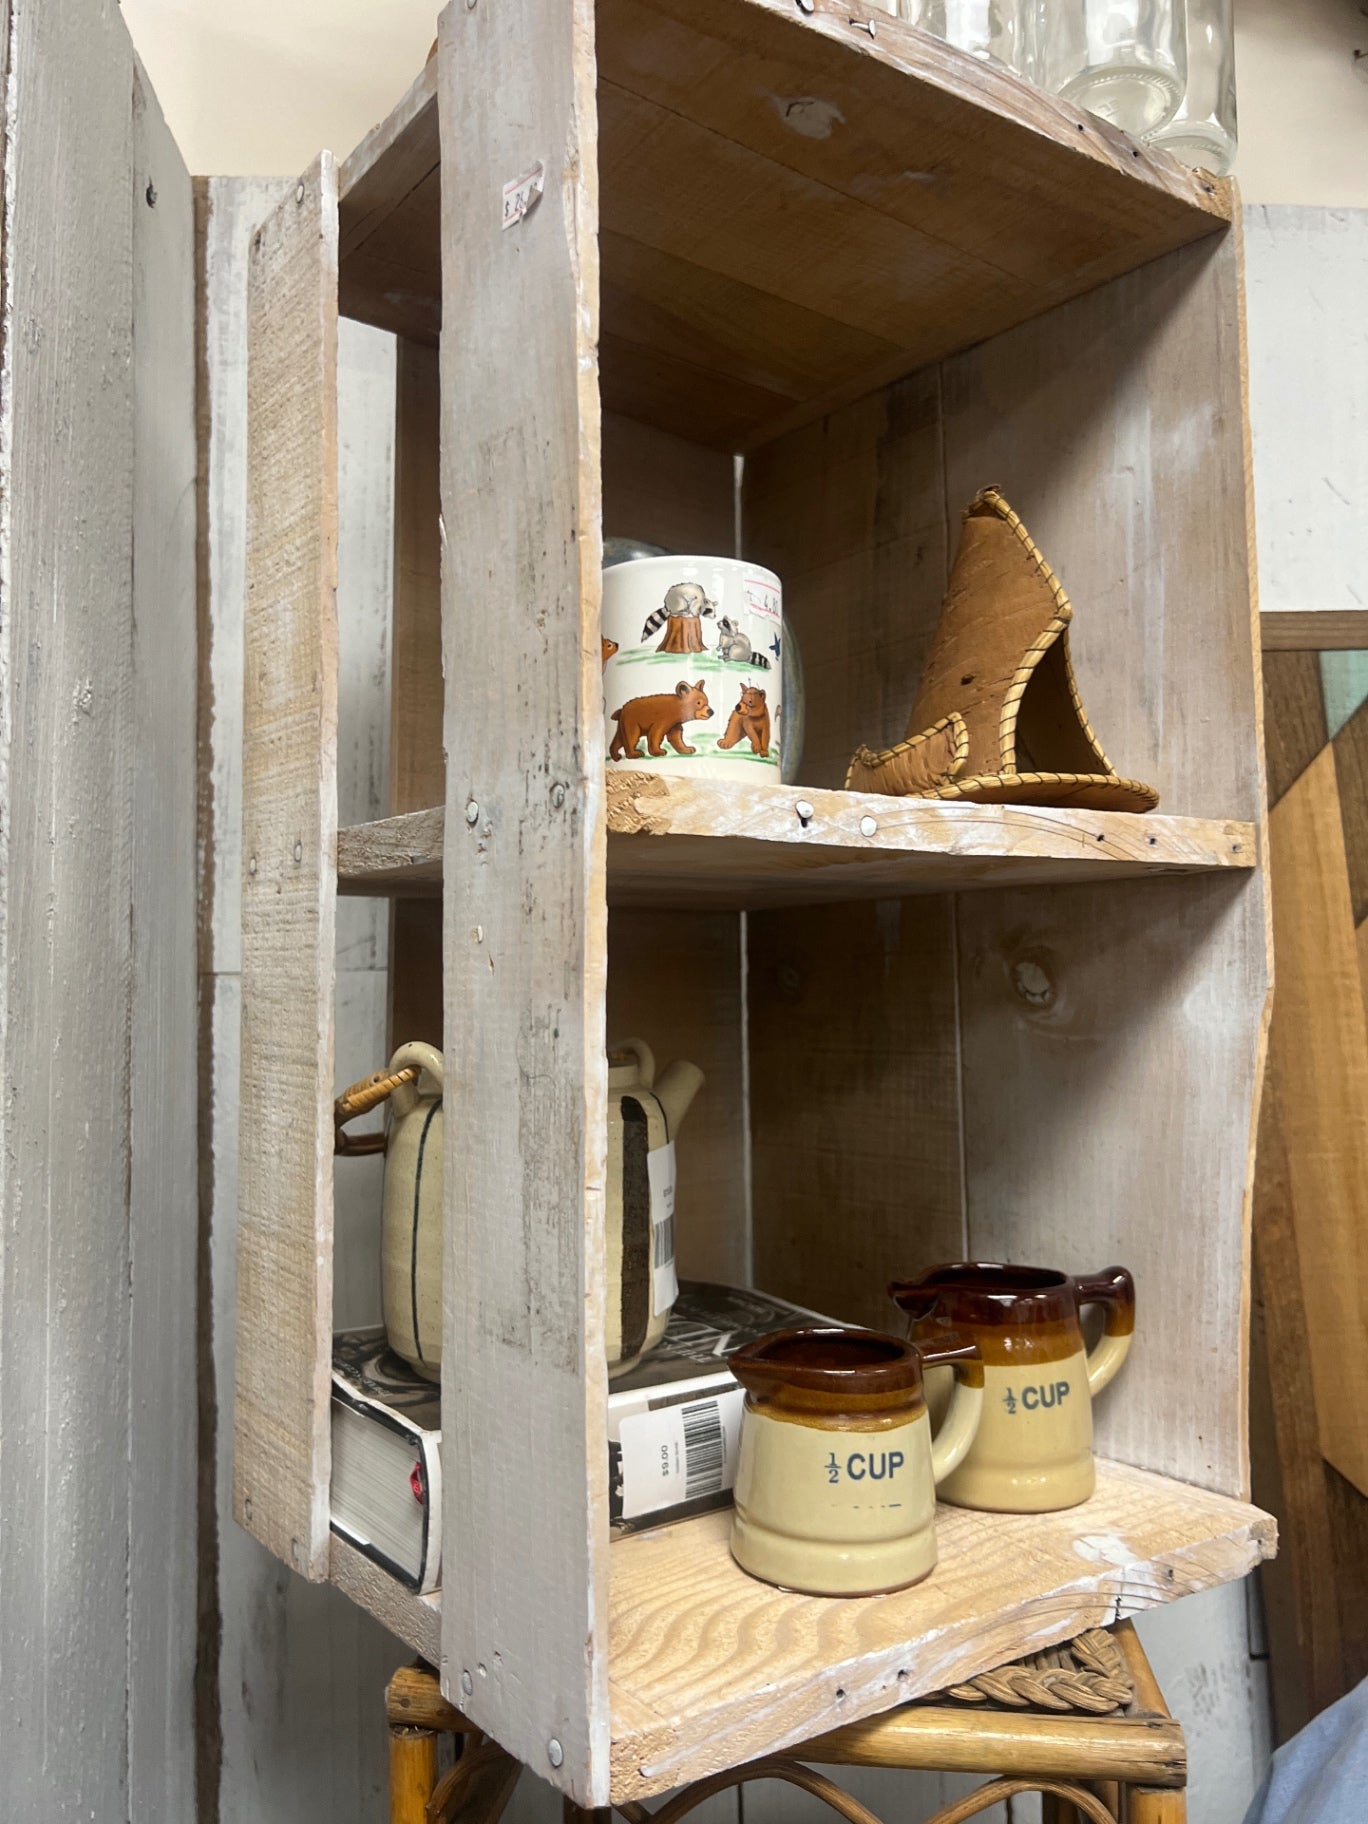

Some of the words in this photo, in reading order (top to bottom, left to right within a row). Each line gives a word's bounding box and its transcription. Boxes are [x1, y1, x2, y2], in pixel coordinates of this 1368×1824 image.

[1021, 1380, 1070, 1411] CUP
[660, 1444, 670, 1477] $9.00
[847, 1451, 904, 1480] CUP
